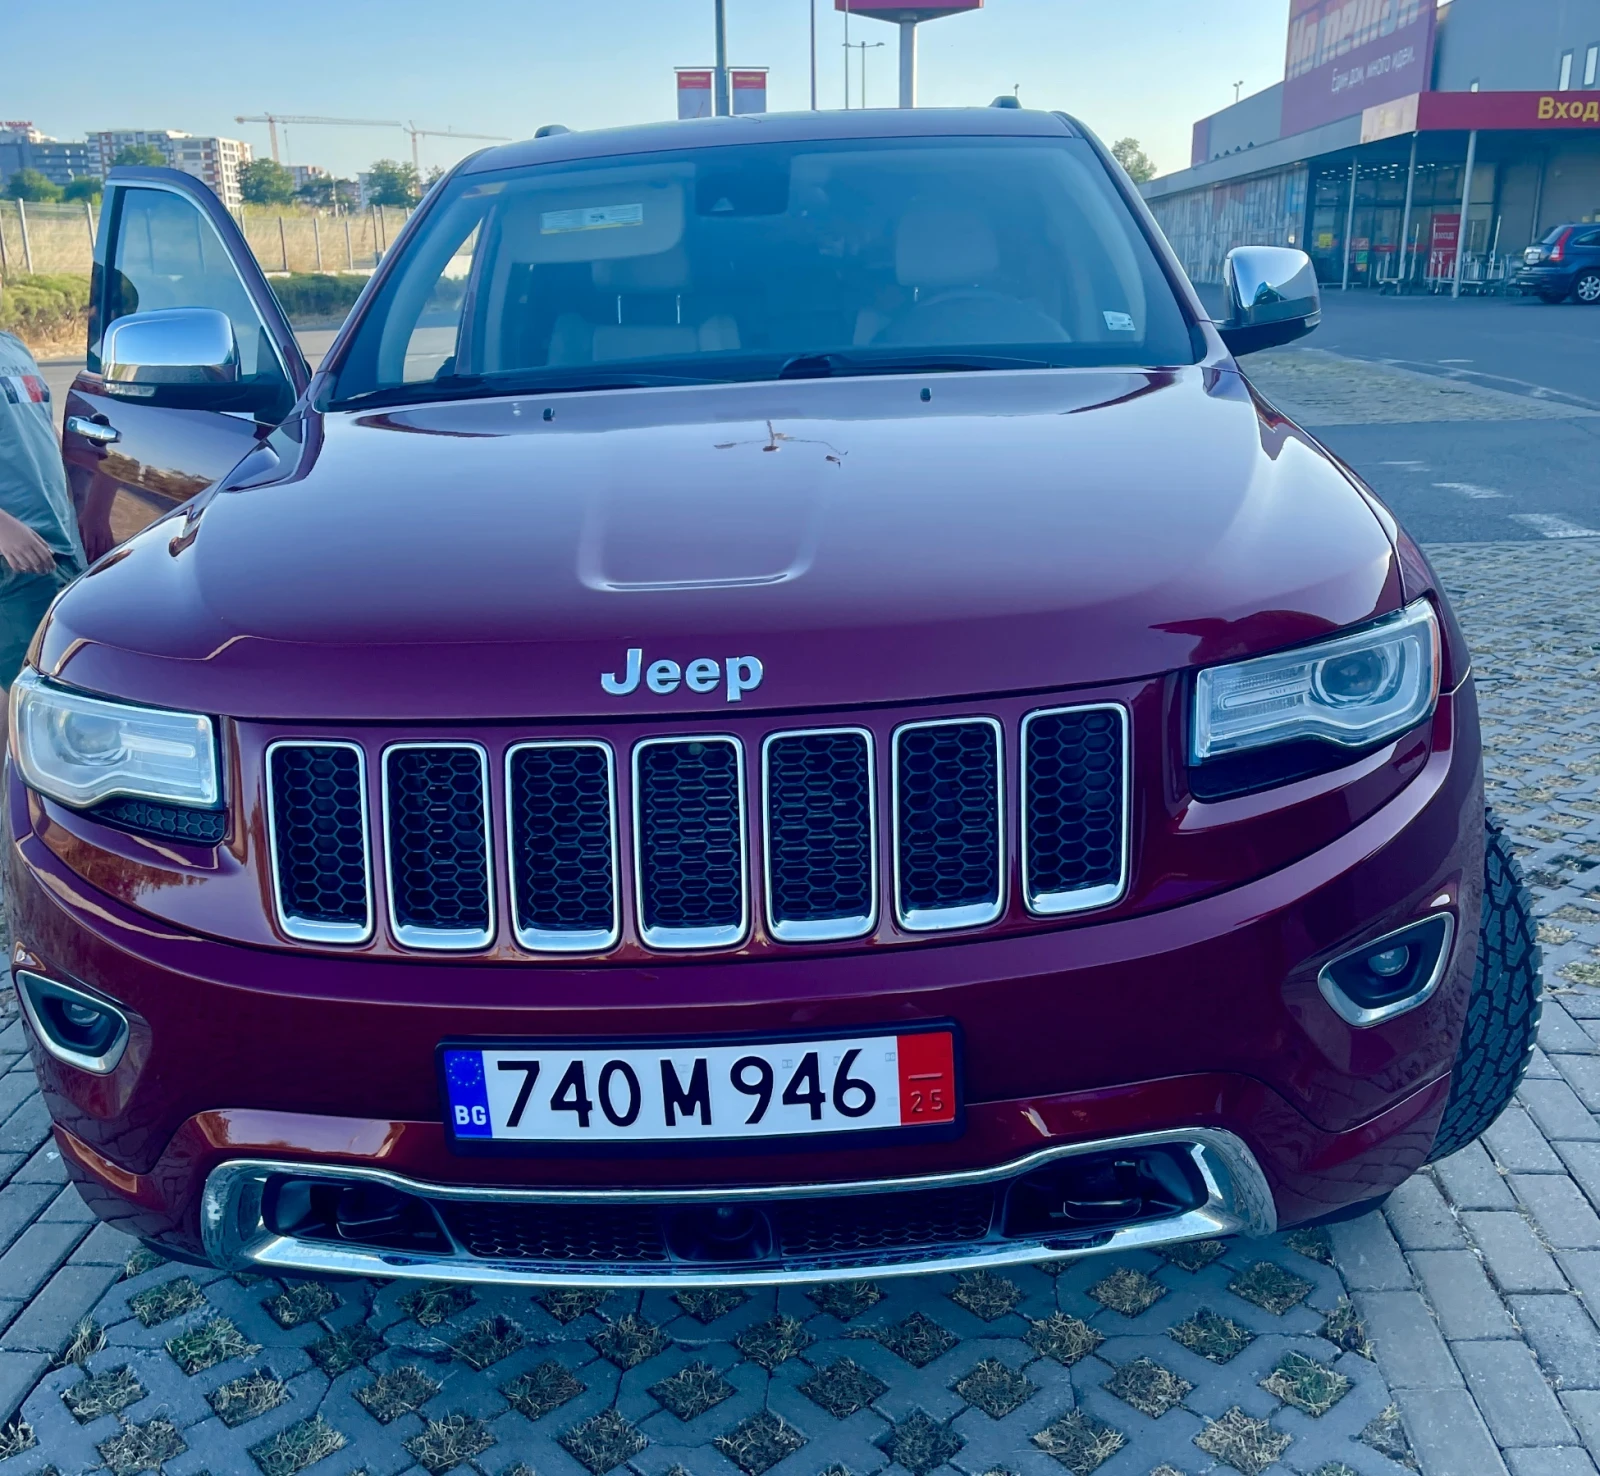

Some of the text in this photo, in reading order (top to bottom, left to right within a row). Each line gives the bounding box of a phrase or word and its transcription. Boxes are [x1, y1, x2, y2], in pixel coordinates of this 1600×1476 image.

[1537, 96, 1599, 122] Вход
[600, 648, 764, 702] Jeep
[496, 1048, 876, 1128] 740 M 946
[910, 1088, 943, 1114] 25
[454, 1105, 487, 1126] BG
